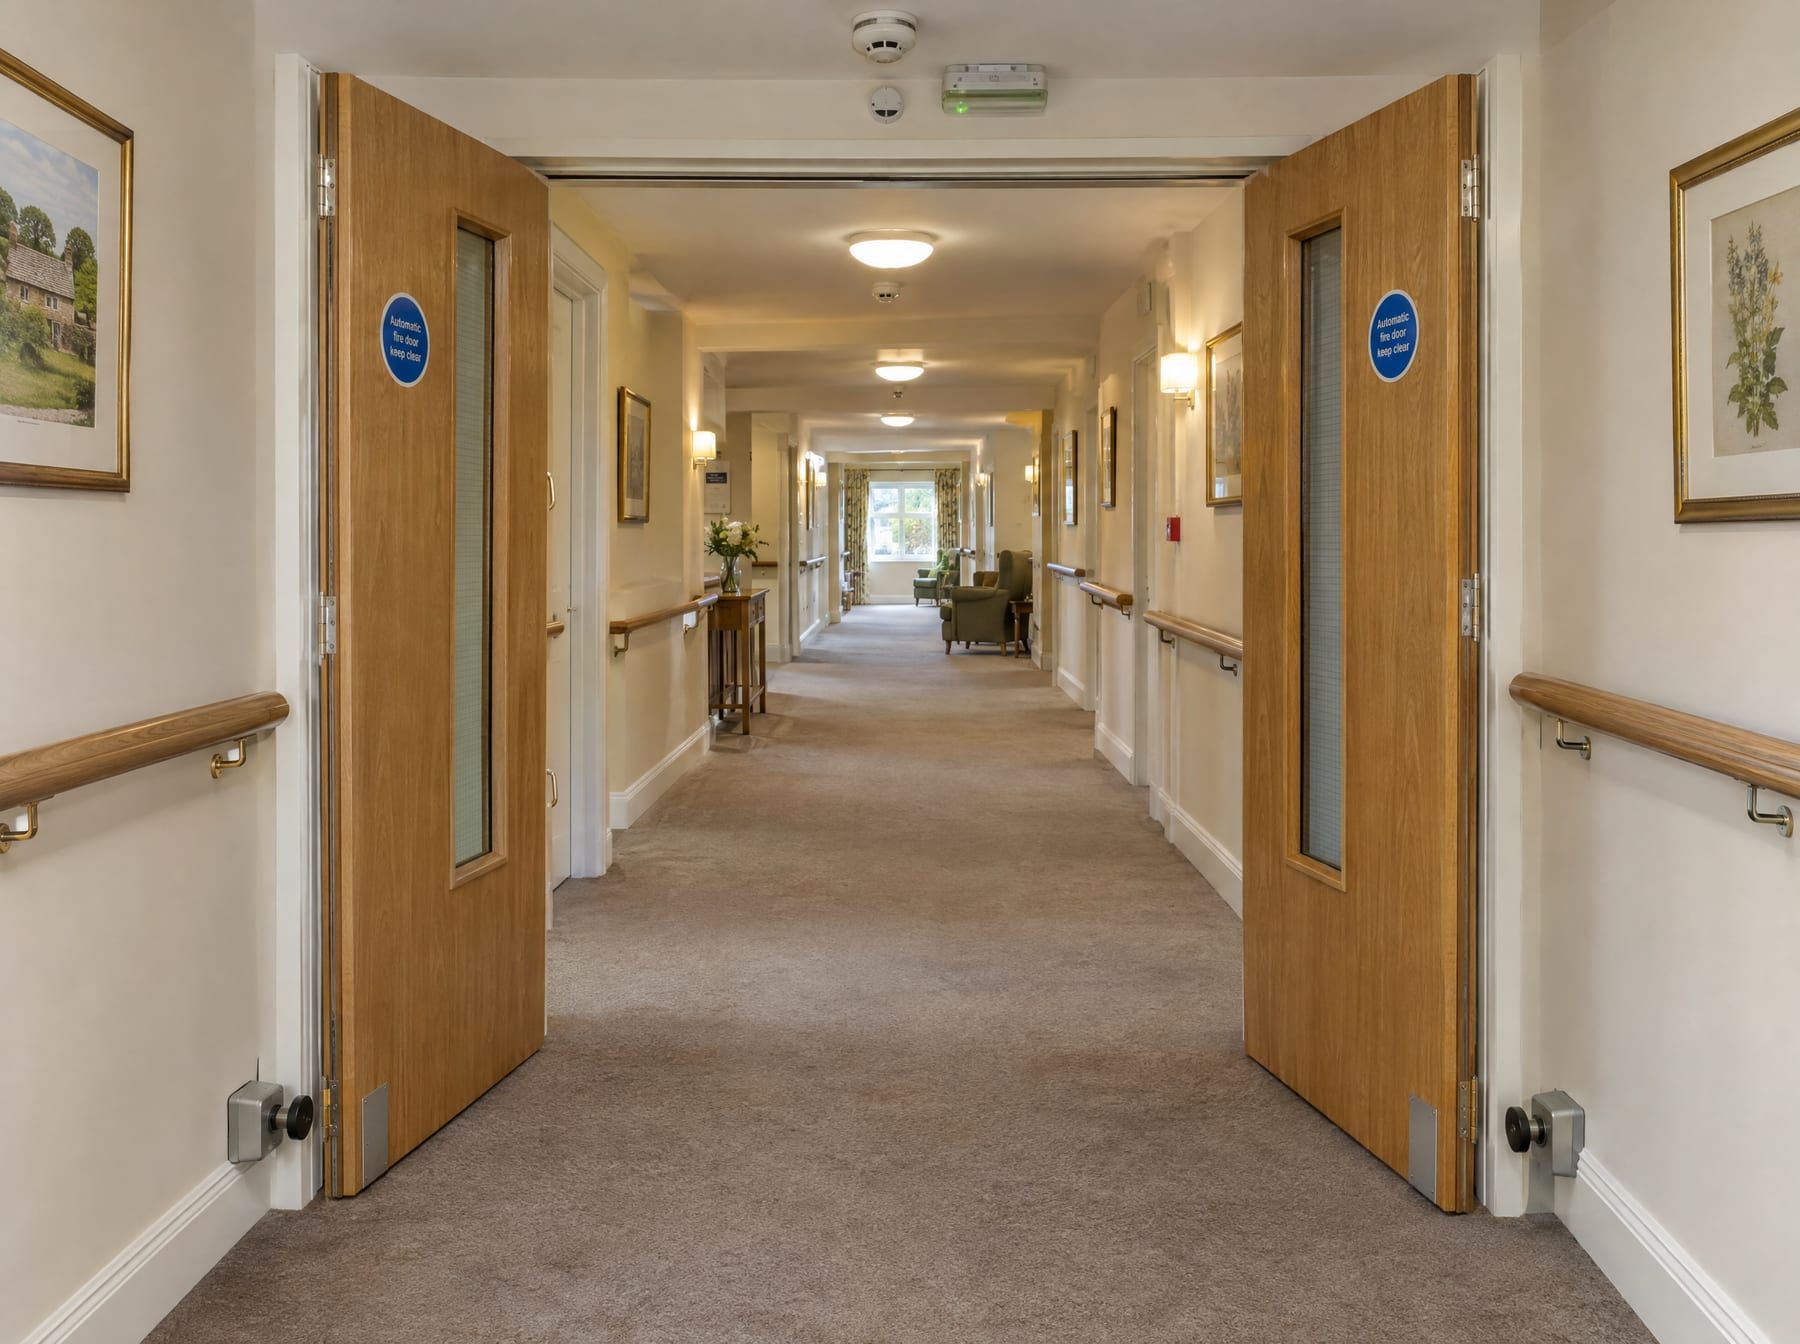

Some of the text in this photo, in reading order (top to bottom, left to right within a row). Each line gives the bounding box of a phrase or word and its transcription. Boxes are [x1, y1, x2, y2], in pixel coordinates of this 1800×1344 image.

[390, 315, 422, 333] Automatic
[1377, 311, 1410, 329] Automatic
[393, 330, 419, 347] fire door
[1380, 328, 1406, 342] fire door
[390, 345, 421, 362] keep clear
[1377, 342, 1410, 358] keep clear
